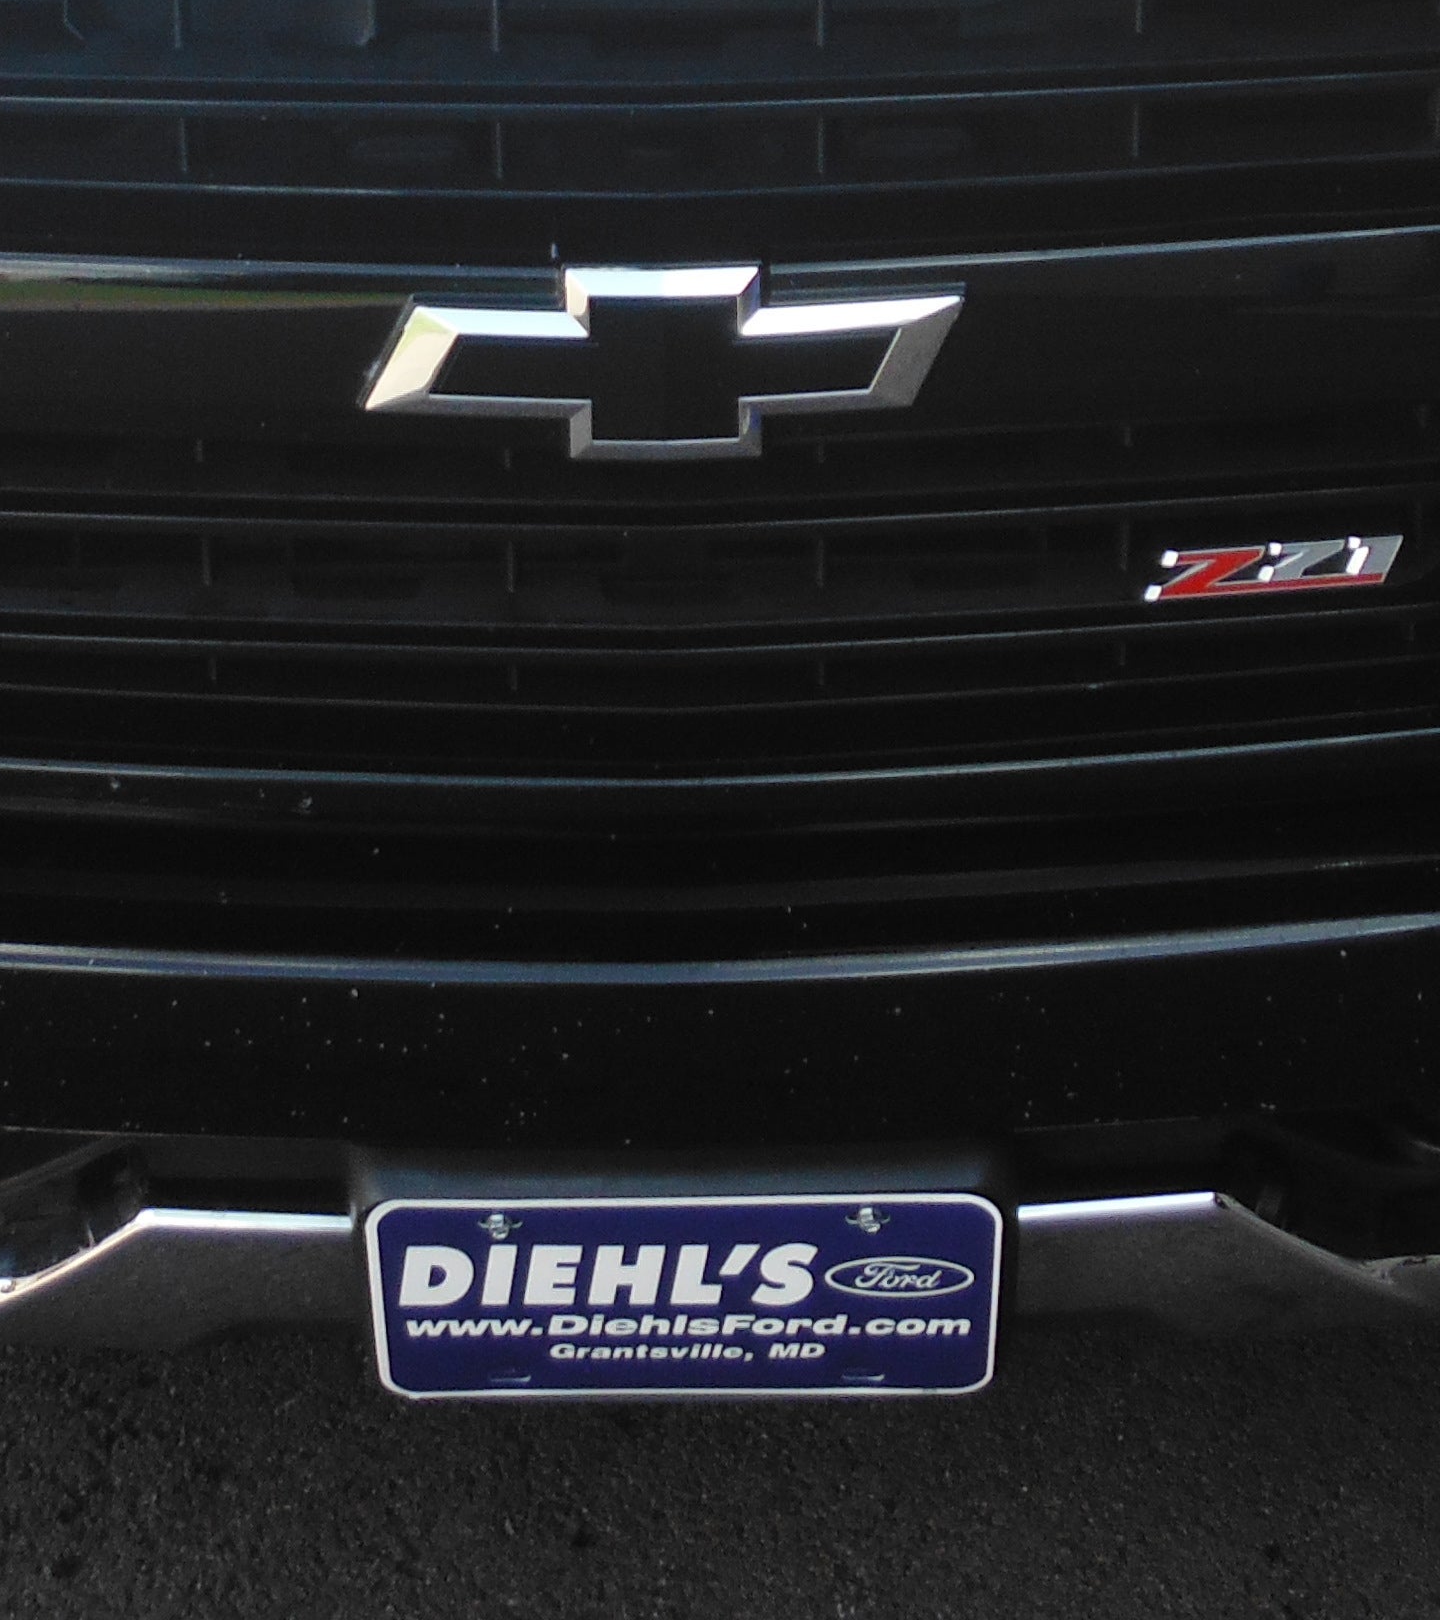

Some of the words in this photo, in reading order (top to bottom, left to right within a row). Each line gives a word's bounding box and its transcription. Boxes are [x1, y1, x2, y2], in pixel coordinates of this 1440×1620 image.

[1144, 535, 1404, 602] Z71
[397, 1243, 819, 1307] DIEHL'S
[852, 1261, 945, 1292] Ford
[405, 1313, 973, 1337] www.DiehlsFord.com
[549, 1342, 754, 1362] Grantsville,
[768, 1342, 826, 1359] MD
